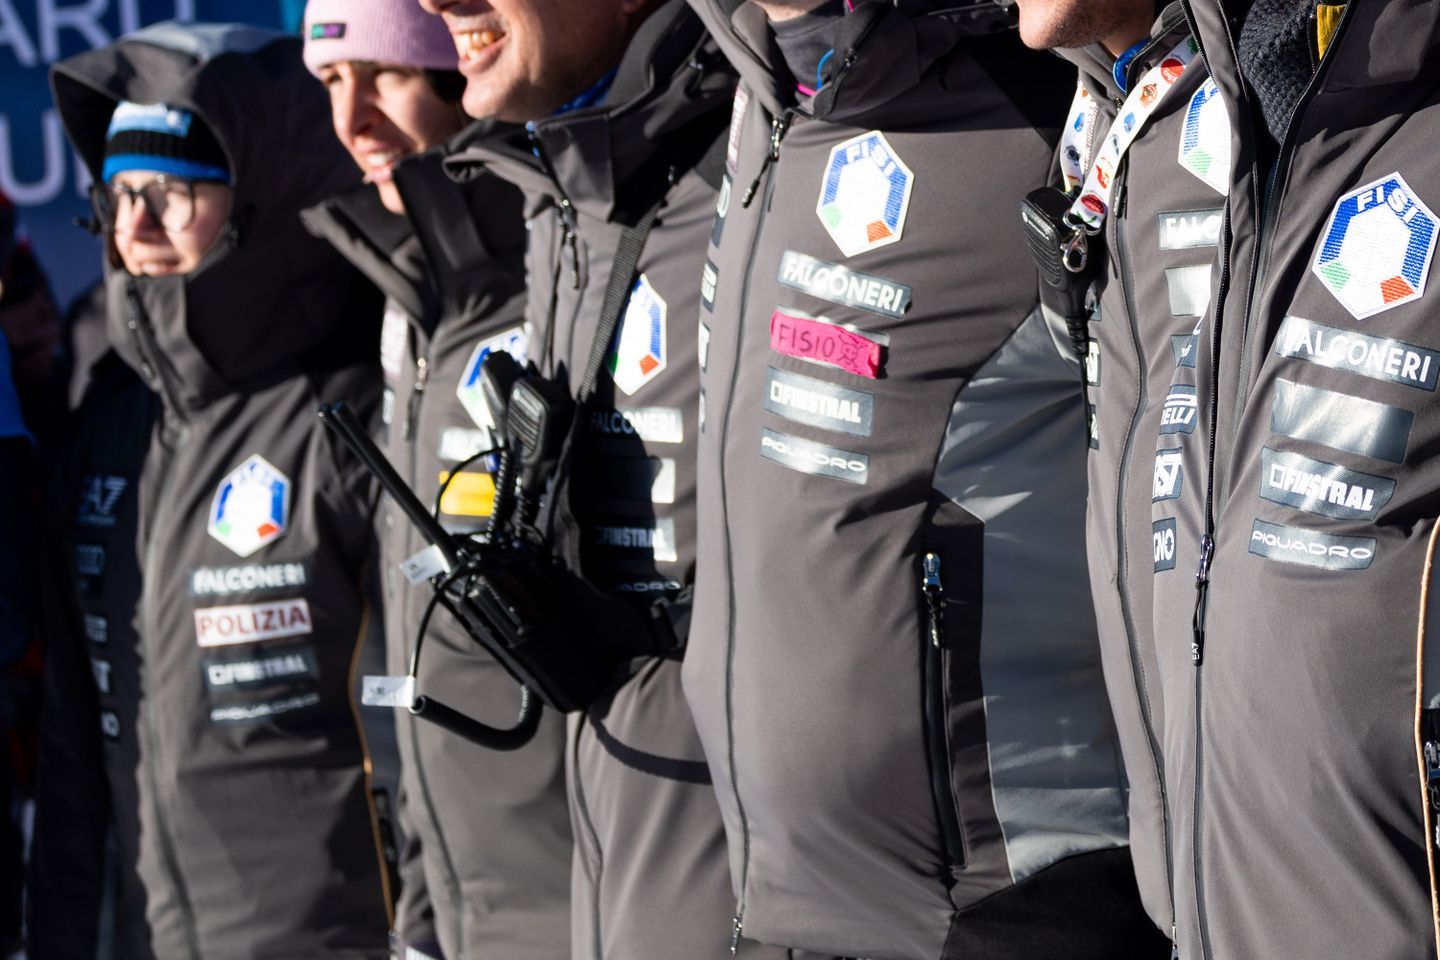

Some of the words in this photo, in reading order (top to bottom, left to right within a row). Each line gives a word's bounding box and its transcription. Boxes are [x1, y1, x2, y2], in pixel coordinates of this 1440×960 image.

[1356, 185, 1418, 225] FISI
[783, 257, 904, 313] FALCONERI
[779, 324, 836, 359] FISIO
[1281, 324, 1432, 383] FALCONERI
[780, 383, 862, 424] FINSTRAL
[1283, 467, 1375, 512] FINSTRAL
[1252, 530, 1371, 560] PIQUADRO
[200, 604, 307, 637] POLIZIA
